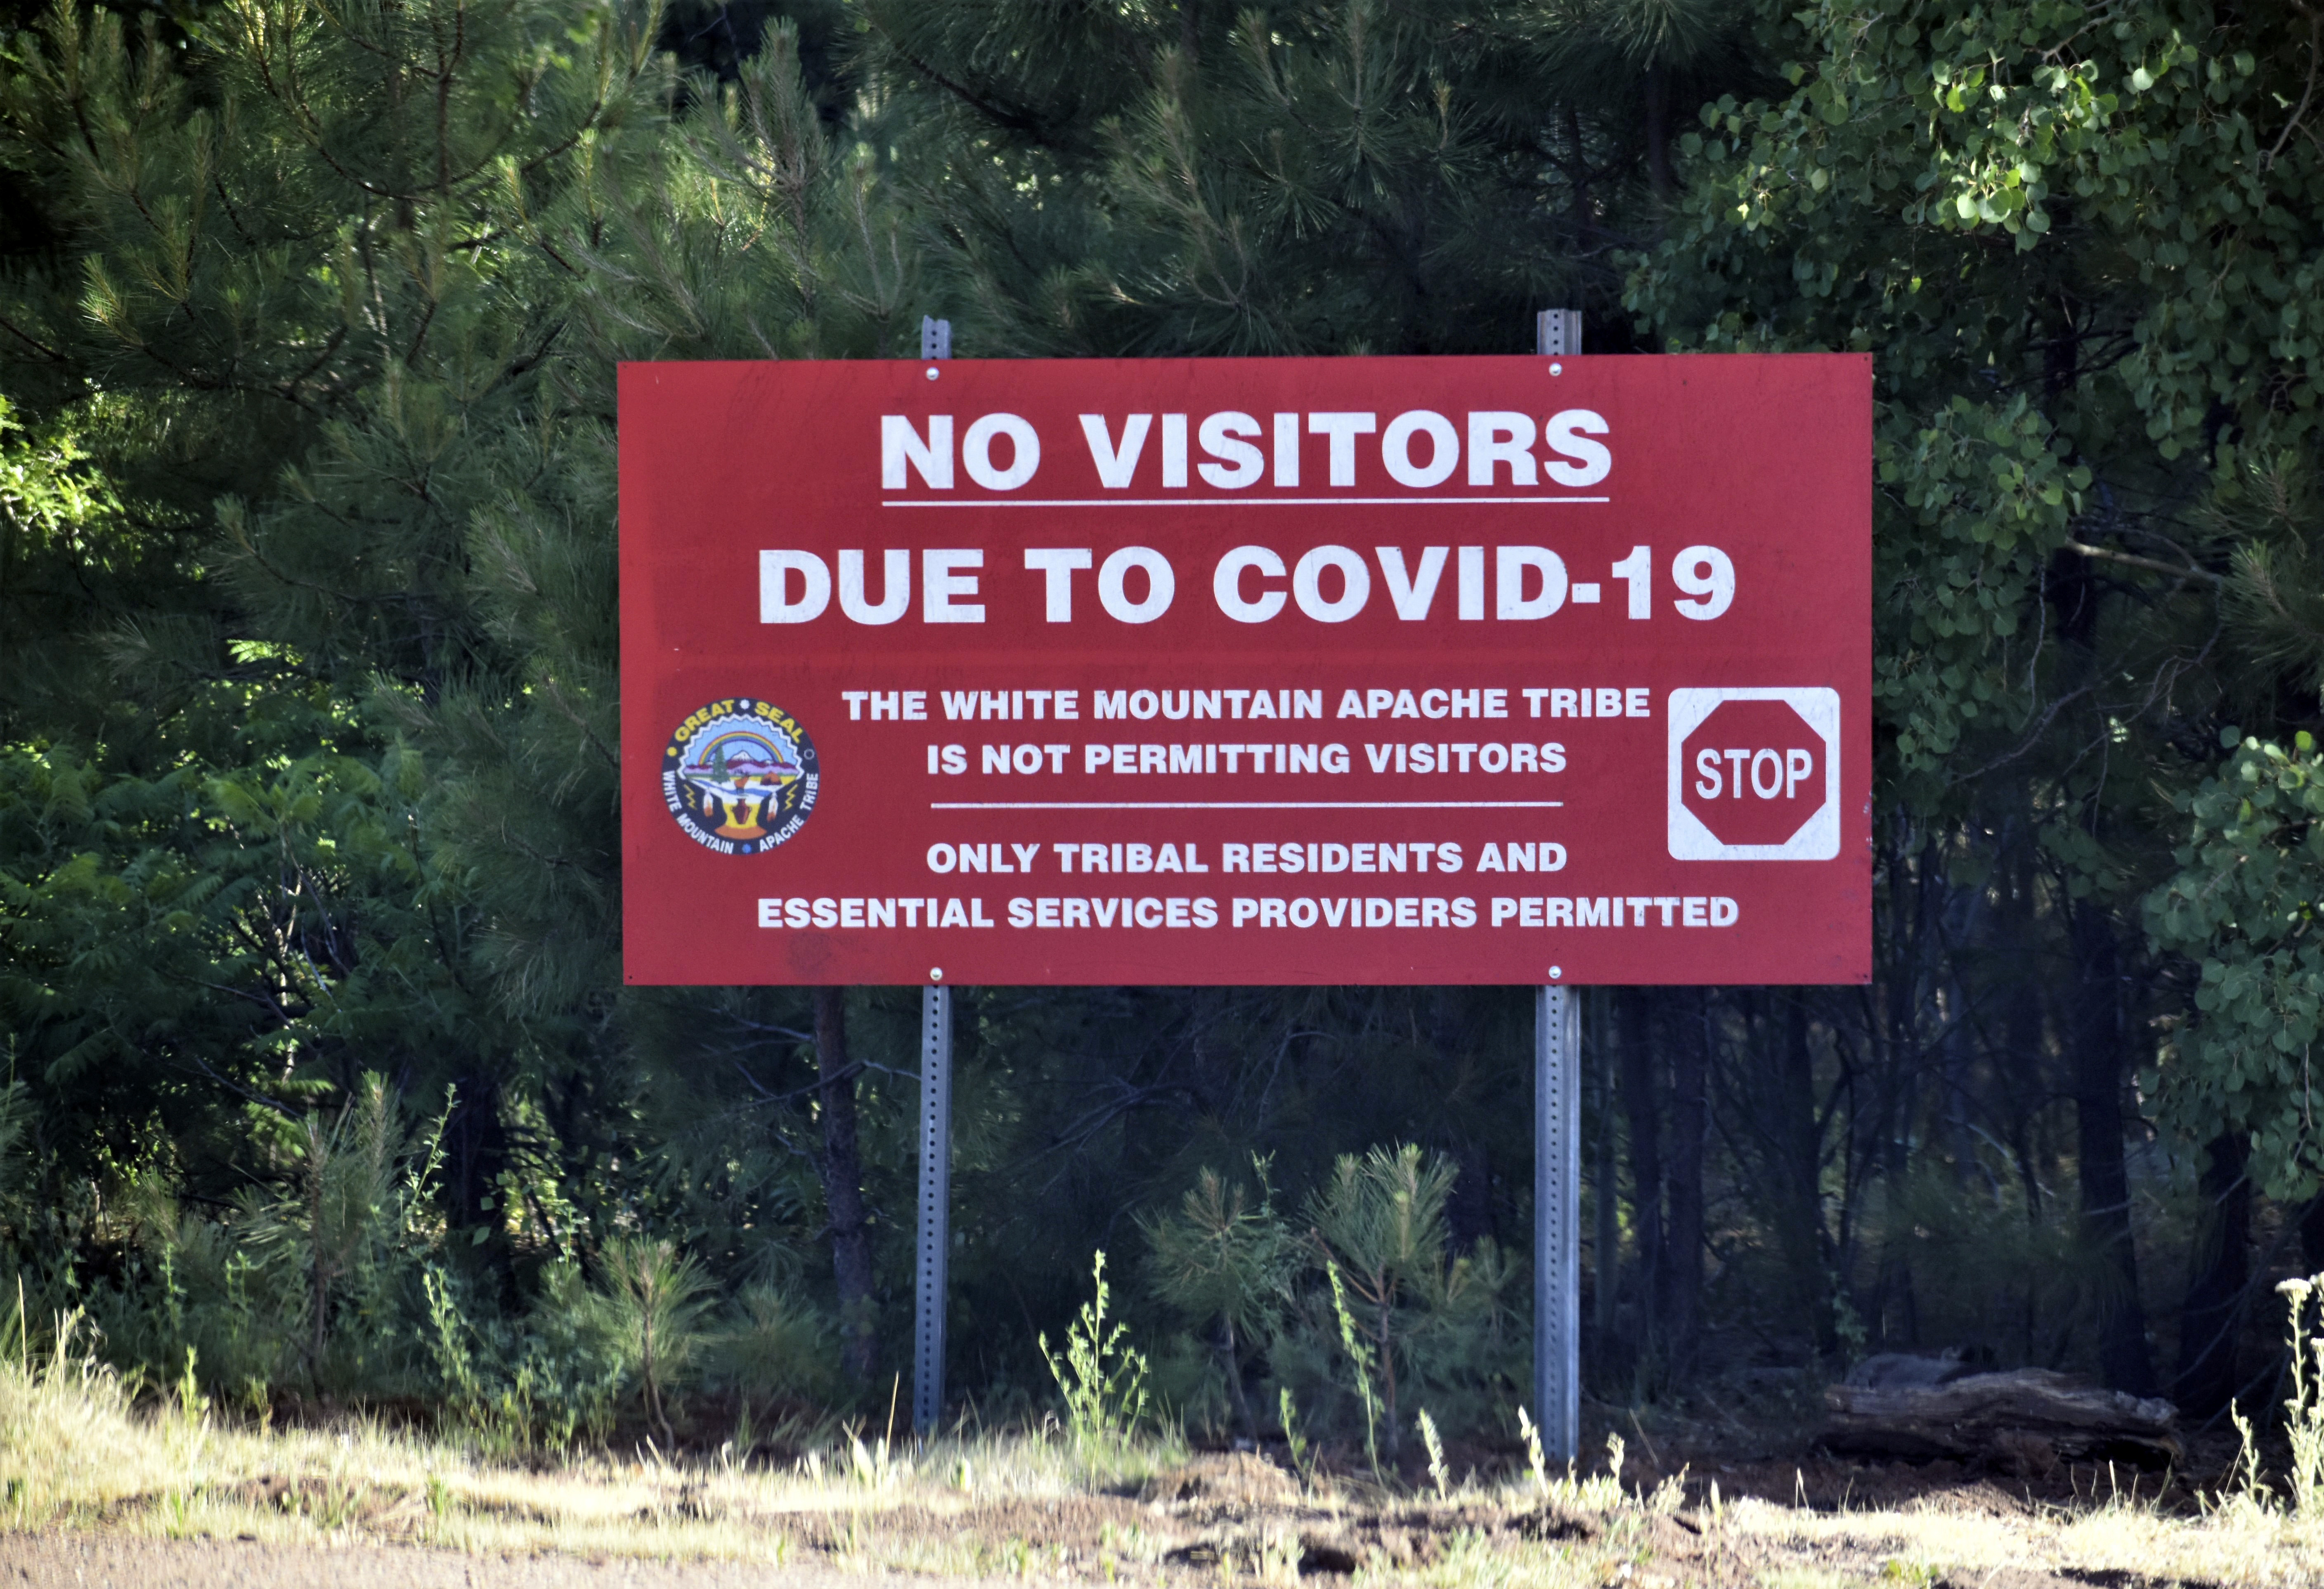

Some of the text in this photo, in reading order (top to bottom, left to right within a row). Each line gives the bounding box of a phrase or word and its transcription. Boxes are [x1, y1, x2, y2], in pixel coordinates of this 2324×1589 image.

[882, 409, 1611, 490] NO VISITORS
[759, 545, 1735, 625] DUE TO COVID-19
[675, 699, 803, 743] GREAT SEAL
[842, 688, 1650, 720] THE WHITE MOUNTAIN APACHE TRIBE
[928, 743, 1566, 774] IS NOT PERMITTING VISITORS
[1696, 748, 1812, 799] STOP
[663, 770, 818, 854] WHITE MOUNTAIN APACHE TRIBE
[927, 843, 1567, 873] ONLY TRIBAL RESIDENTS AND
[758, 897, 1738, 928] ESSENTIAL SERVICES PROVIDERS PERMITTED
